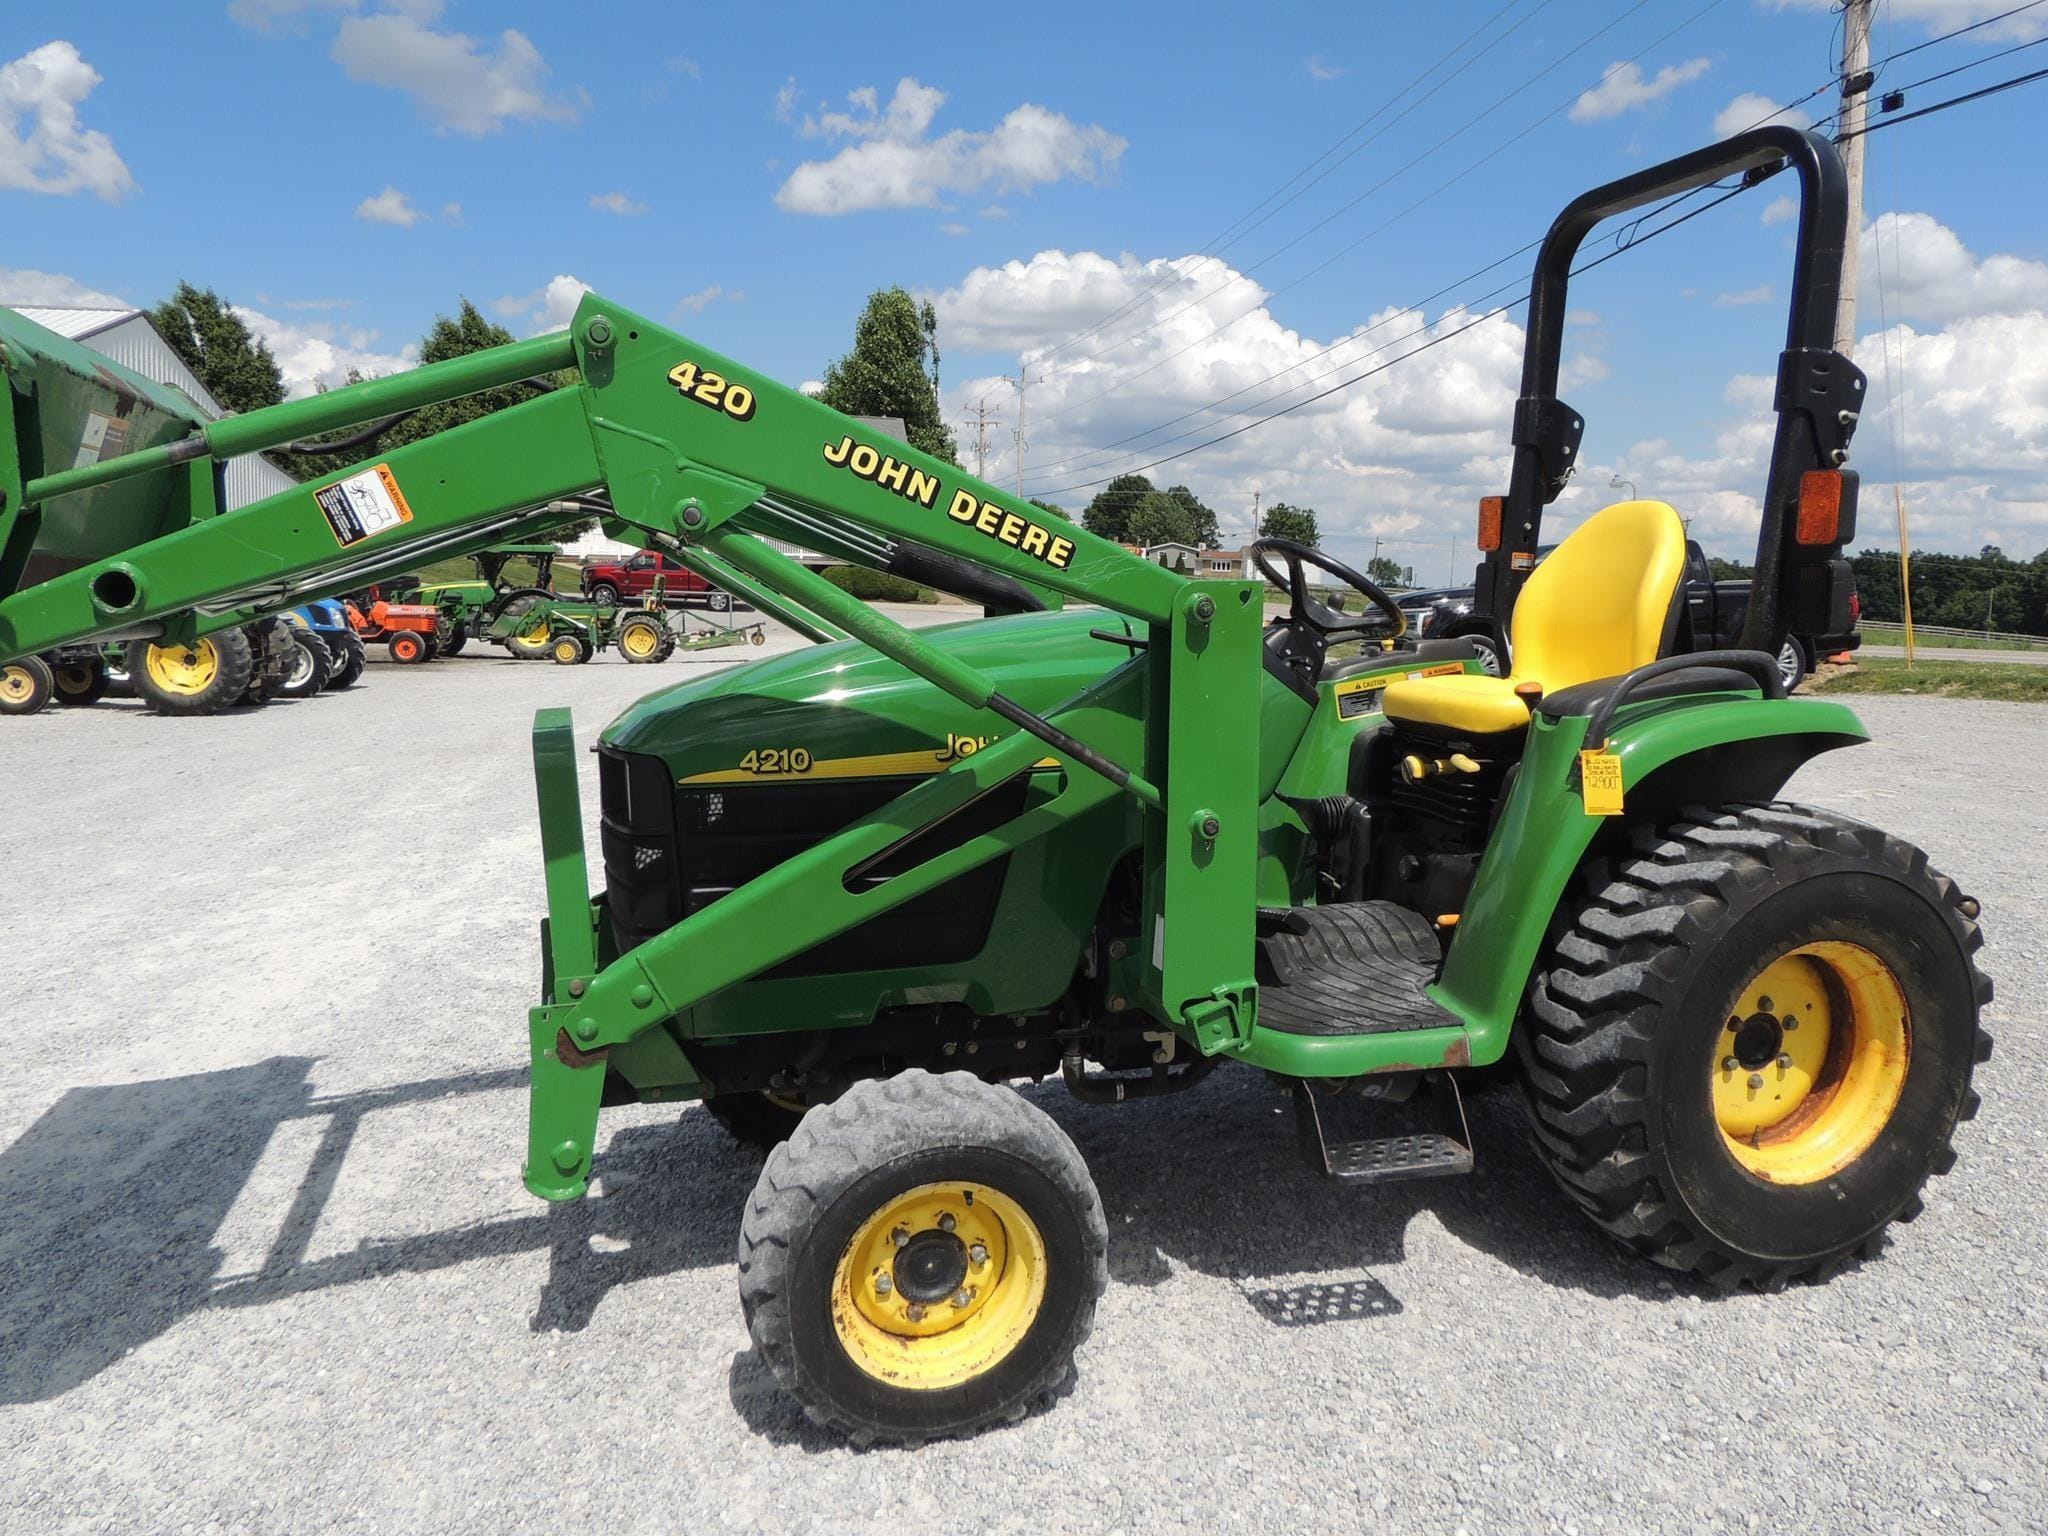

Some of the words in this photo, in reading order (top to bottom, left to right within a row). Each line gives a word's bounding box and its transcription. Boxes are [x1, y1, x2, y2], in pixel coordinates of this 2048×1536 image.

[667, 360, 755, 421] 420
[385, 480, 408, 517] WARNING
[823, 435, 941, 509] JOHN
[948, 488, 1076, 571] DEERE
[1362, 679, 1387, 688] CAUTION
[739, 747, 813, 774] 4210
